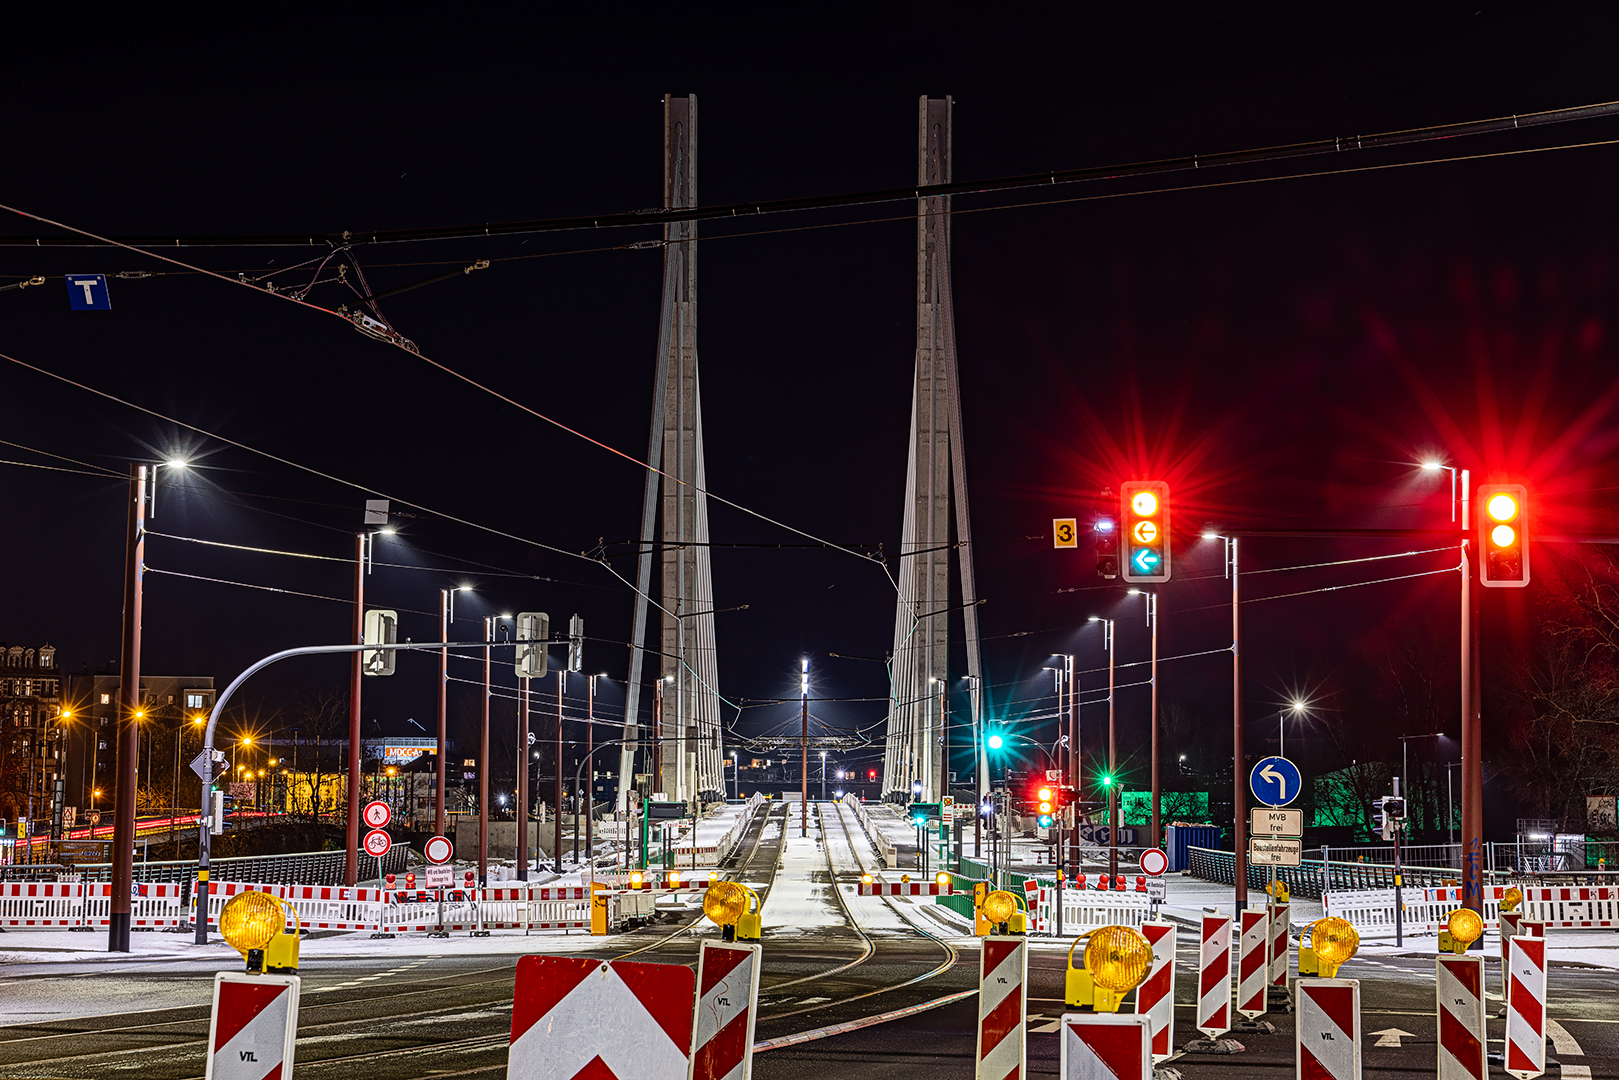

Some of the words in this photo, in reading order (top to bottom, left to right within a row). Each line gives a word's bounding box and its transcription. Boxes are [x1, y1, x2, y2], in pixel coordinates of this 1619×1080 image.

[74, 280, 98, 305] T
[1059, 525, 1073, 542] 3
[1268, 813, 1287, 821] MVB
[1253, 843, 1299, 855] Baustellenfahrzeuge
[1270, 853, 1282, 862] frei
[717, 997, 731, 1006] VTL
[239, 1051, 258, 1062] VTL
